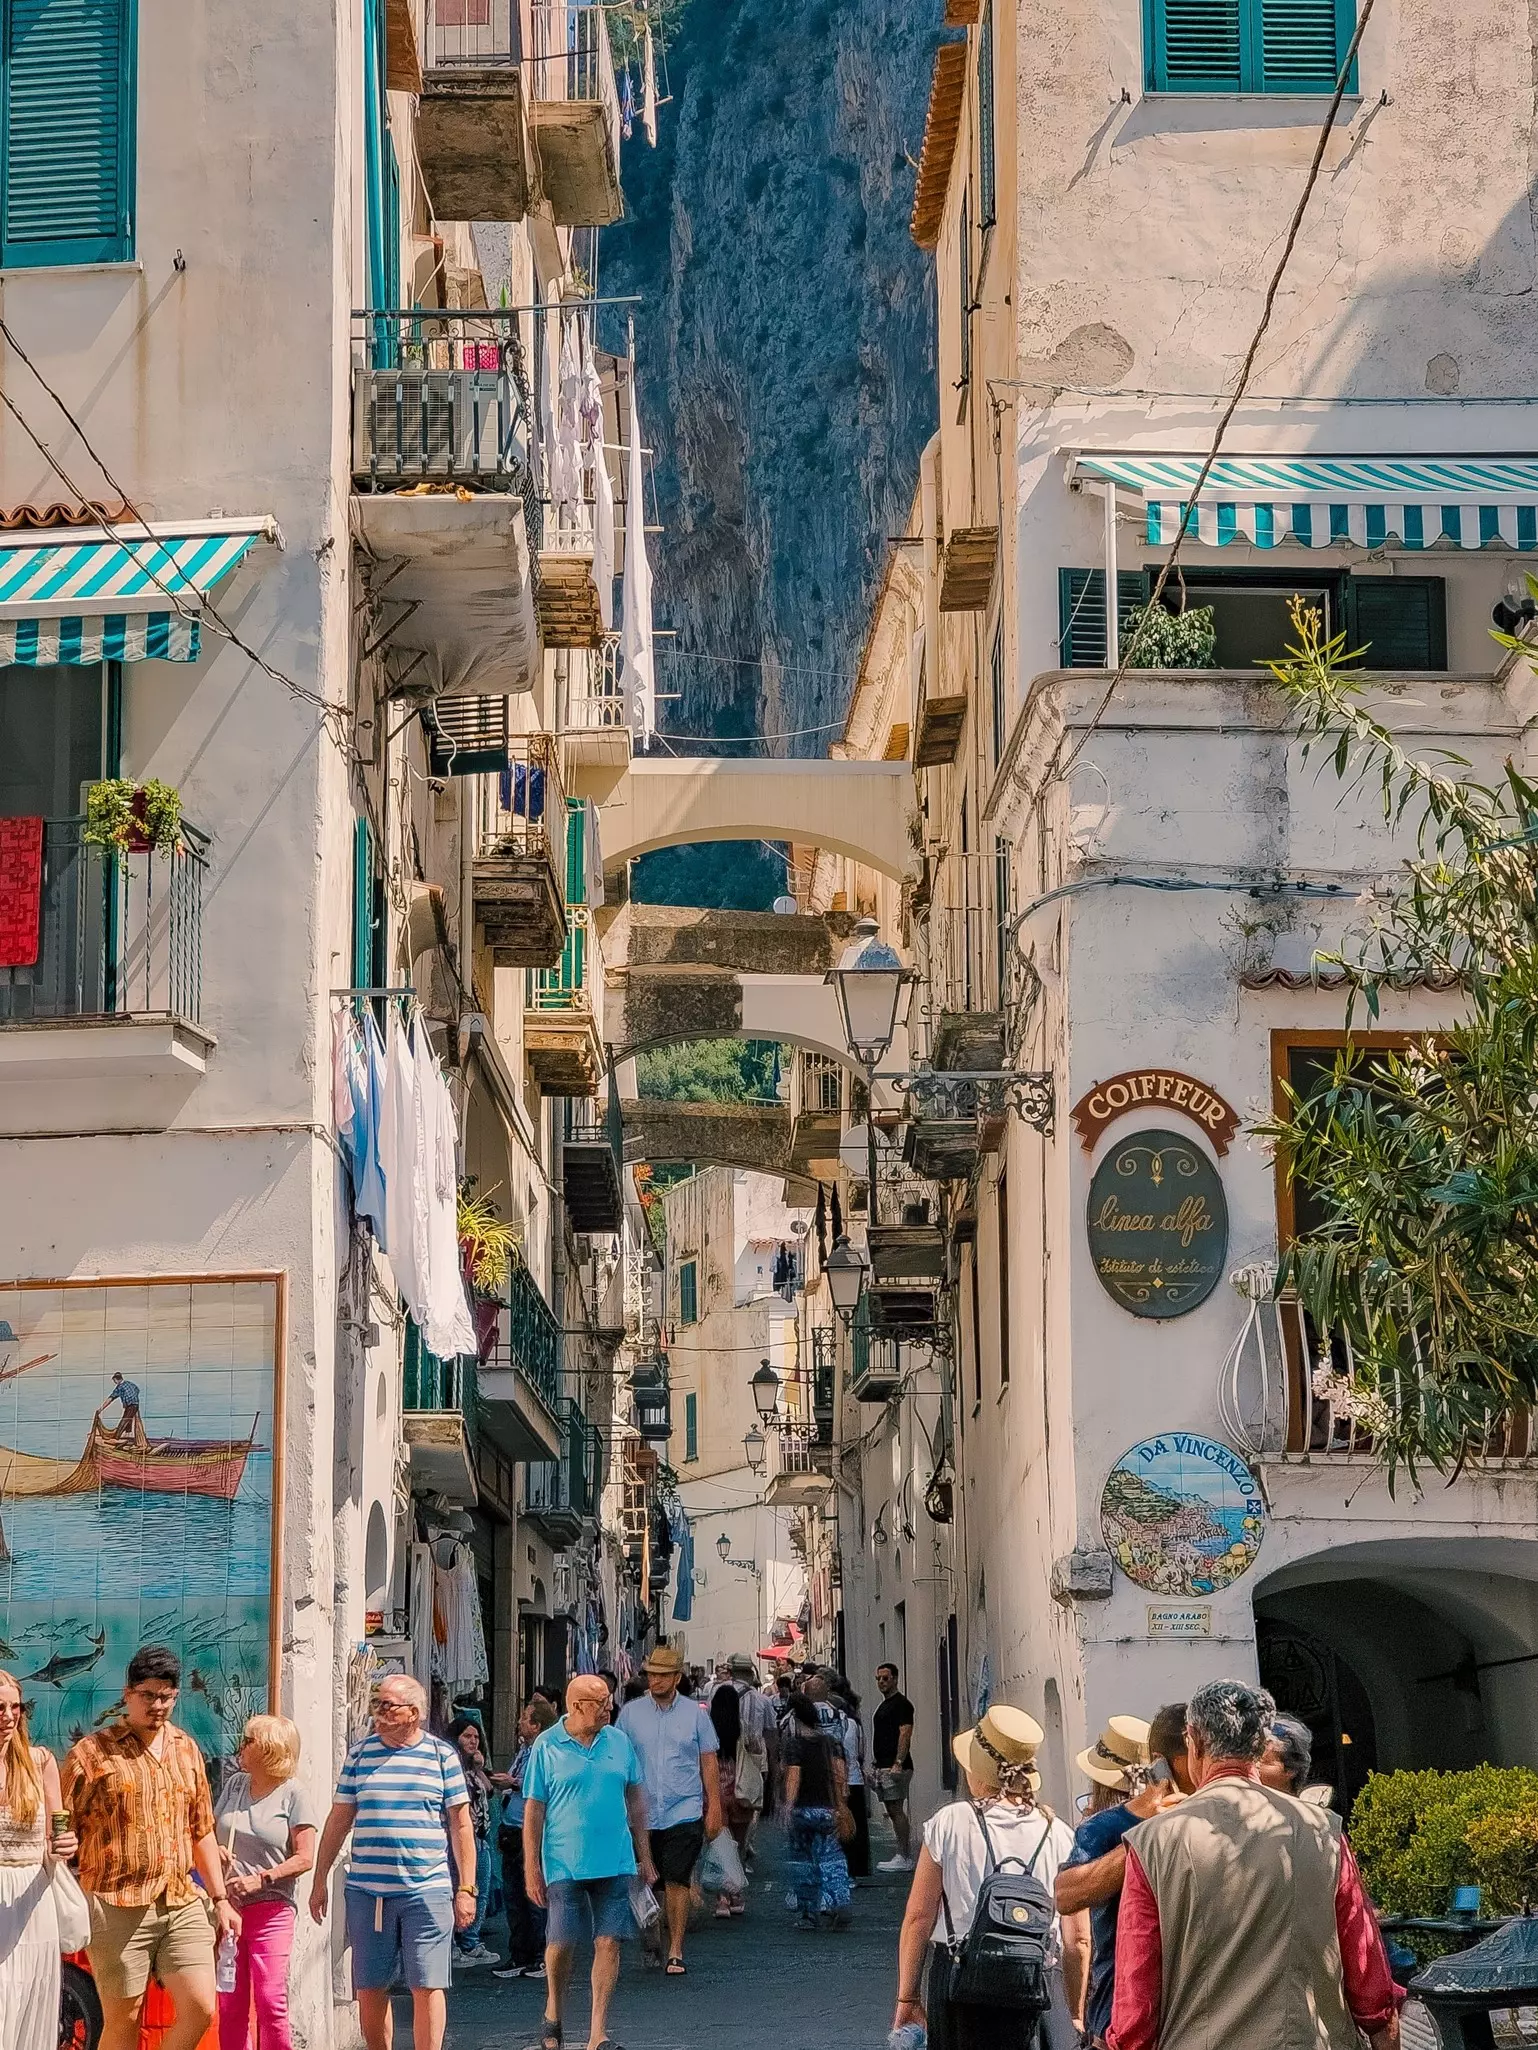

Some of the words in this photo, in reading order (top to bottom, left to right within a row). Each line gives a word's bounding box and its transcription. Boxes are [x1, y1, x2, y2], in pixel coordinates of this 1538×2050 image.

[1088, 1074, 1226, 1129] COIFFEUR
[1093, 1194, 1156, 1231] linea
[1159, 1196, 1214, 1247] alfa
[1148, 1257, 1163, 1273] di
[1138, 1439, 1170, 1463] DA
[1173, 1435, 1255, 1496] VINCENZO
